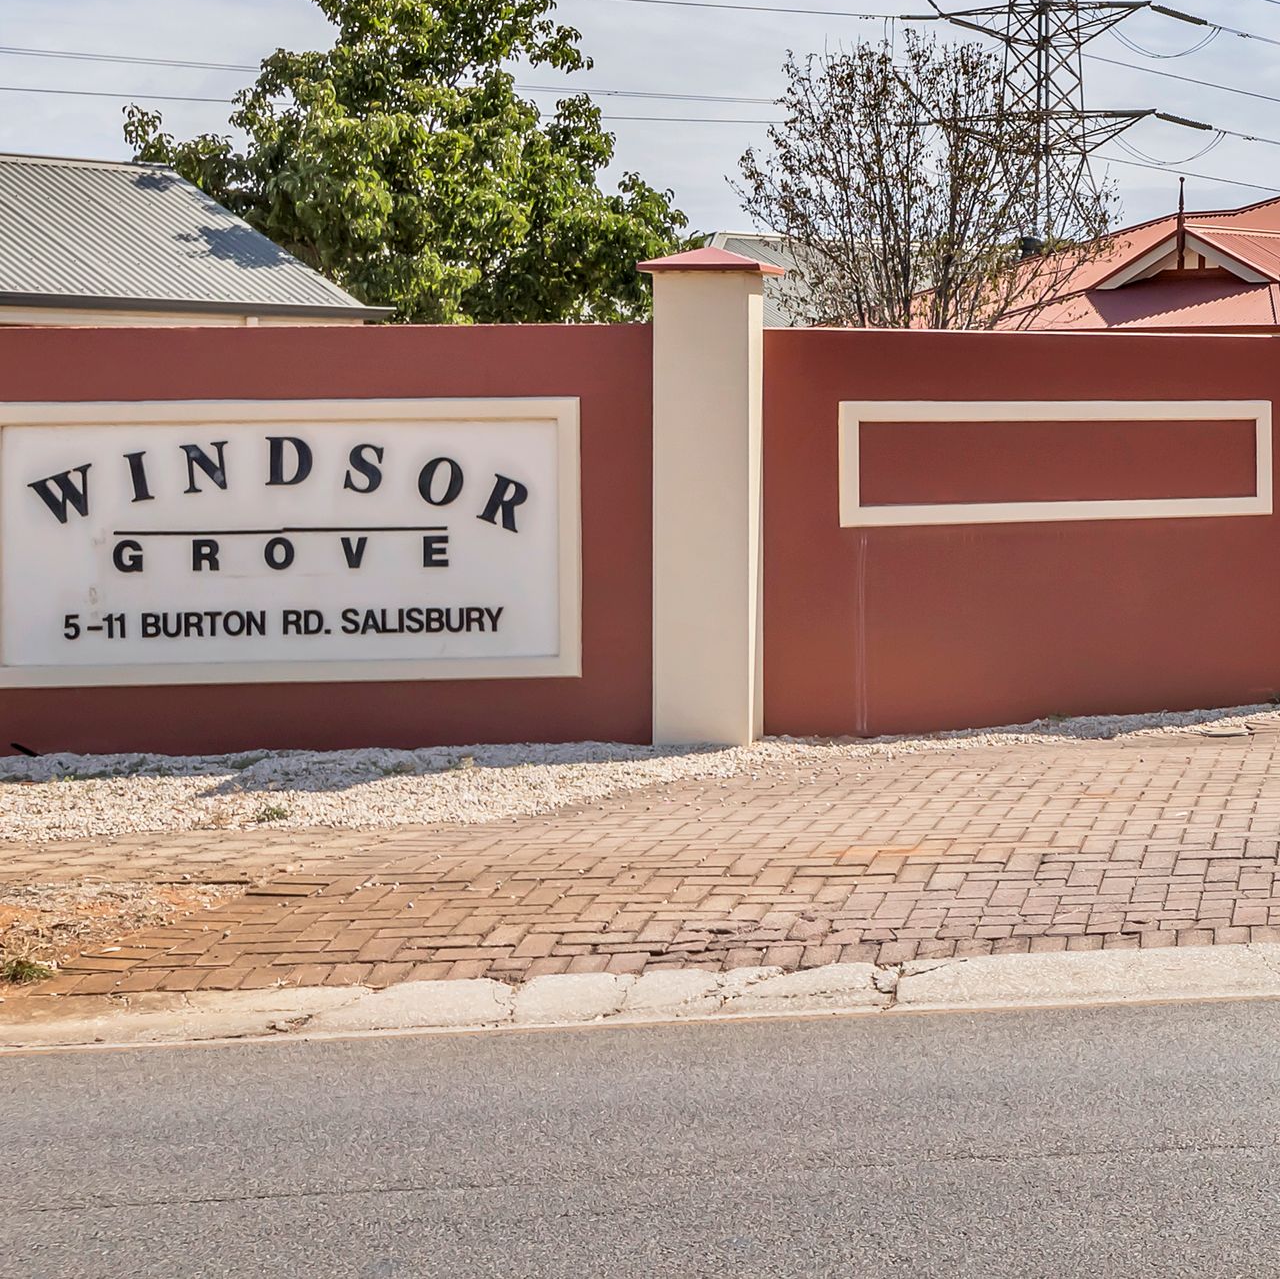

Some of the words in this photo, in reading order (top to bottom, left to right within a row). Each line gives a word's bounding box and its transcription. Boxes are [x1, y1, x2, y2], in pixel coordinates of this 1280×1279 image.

[27, 436, 529, 534] WINDSOR
[112, 535, 450, 573] GROVE
[63, 612, 127, 641] 5-11
[141, 610, 266, 639] BURTON
[282, 609, 332, 636] RD.
[340, 606, 504, 636] SALISBURY
